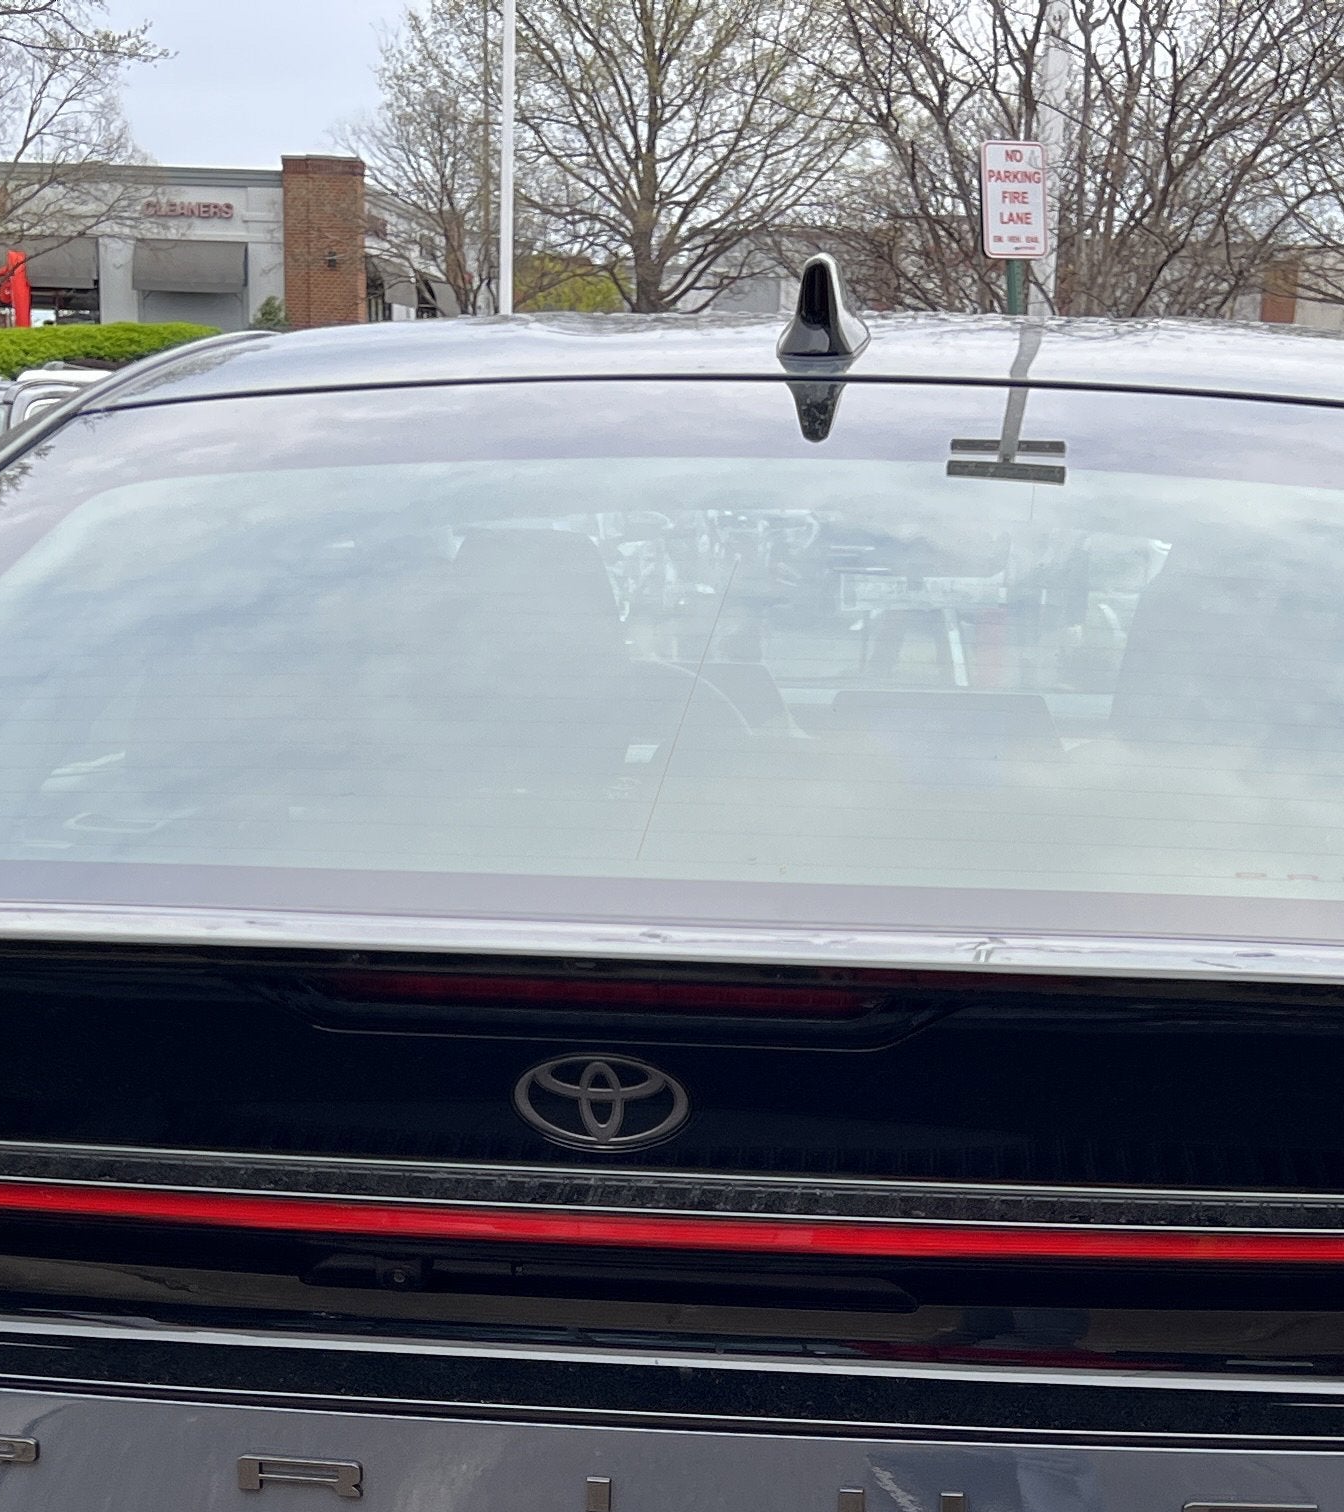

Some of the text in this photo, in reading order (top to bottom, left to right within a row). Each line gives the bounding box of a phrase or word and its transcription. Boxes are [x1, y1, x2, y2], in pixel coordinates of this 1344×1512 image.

[1004, 149, 1023, 162] NO
[987, 169, 1041, 184] PARKING
[1001, 191, 1030, 204] FIRE
[143, 200, 234, 219] CLEANERS
[999, 212, 1032, 225] LANE
